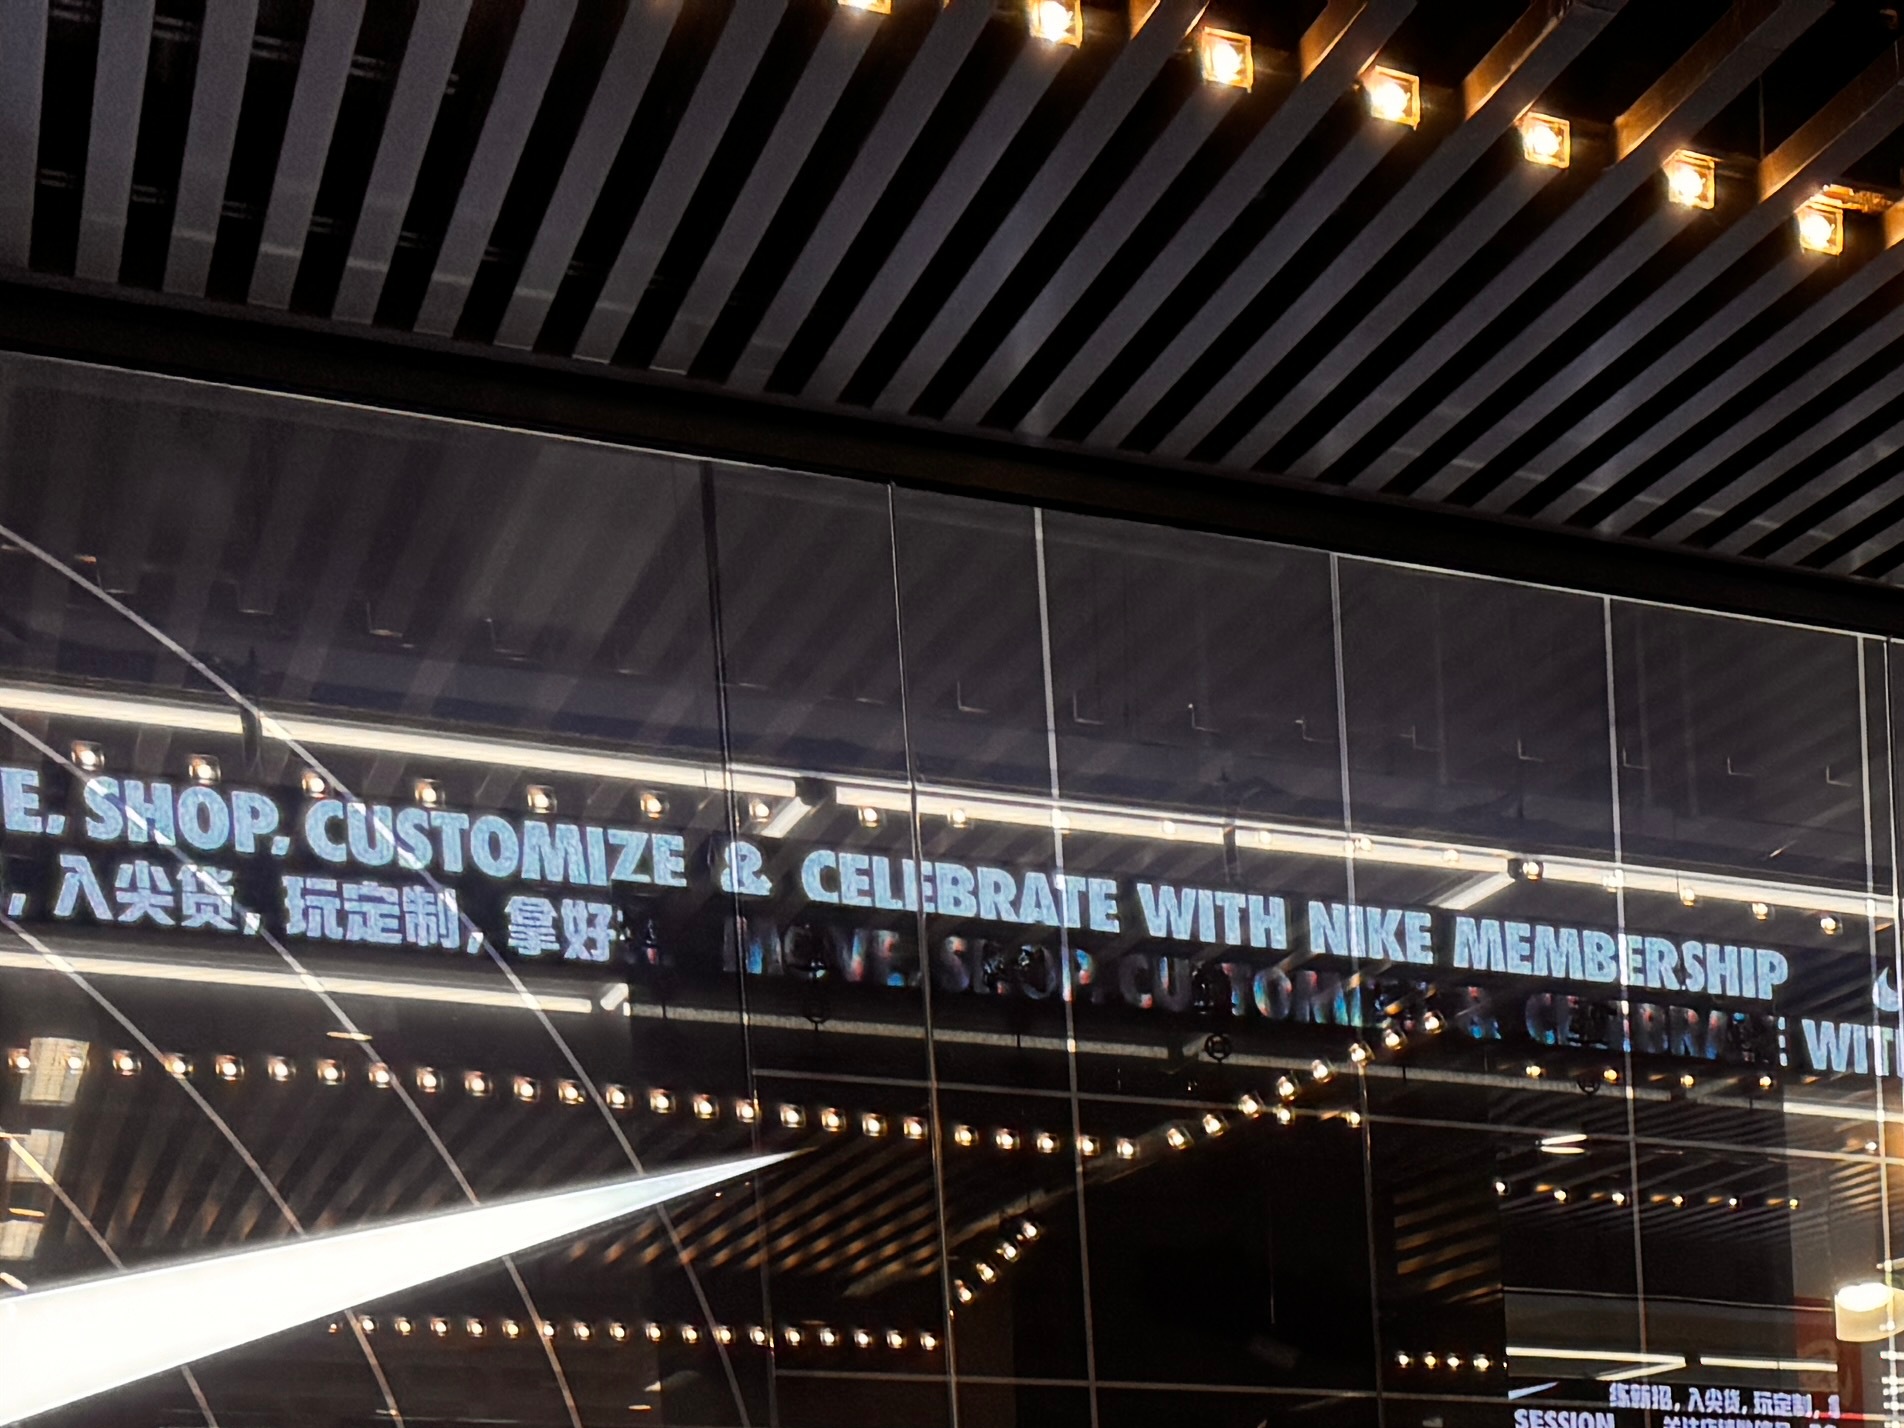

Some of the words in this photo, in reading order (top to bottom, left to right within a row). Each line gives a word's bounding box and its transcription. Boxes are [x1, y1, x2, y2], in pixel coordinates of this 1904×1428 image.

[305, 798, 688, 888] CUSTOMIZE
[720, 841, 772, 897] &
[801, 849, 1119, 934] CELEBRATE
[1136, 881, 1286, 950] WITH
[1309, 900, 1434, 965] NIKE
[1453, 916, 1788, 1000] MEMBERSHIP
